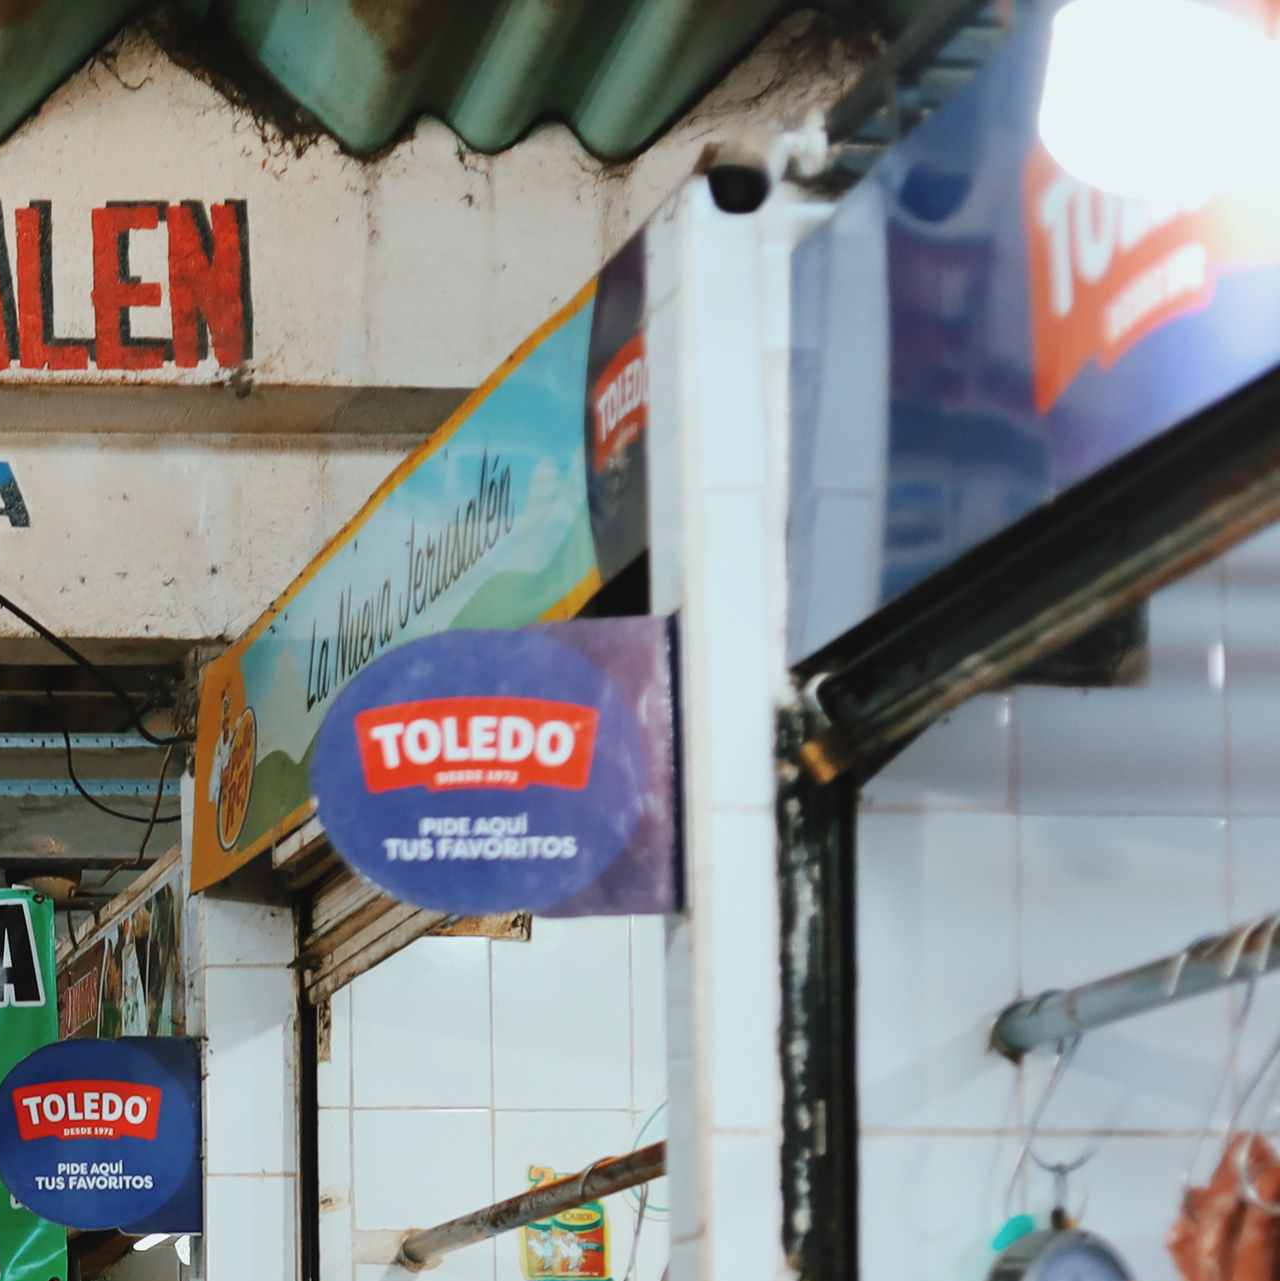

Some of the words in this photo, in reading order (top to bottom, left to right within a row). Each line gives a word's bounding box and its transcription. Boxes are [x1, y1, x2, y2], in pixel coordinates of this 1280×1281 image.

[306, 617, 331, 714] La
[336, 577, 393, 690] Nueva
[370, 714, 576, 769] TOLEDO
[419, 816, 470, 836] PIDE
[471, 812, 529, 839] AQUÍ
[383, 837, 434, 861] TUS
[437, 836, 578, 861] FAVORITOS
[21, 1091, 148, 1126] TOLEDO
[63, 1127, 92, 1137] DESDE
[94, 1126, 114, 1136] 1972
[57, 1162, 88, 1175] PIDE
[90, 1159, 123, 1177] AQUÍ
[35, 1176, 65, 1191] TUS
[68, 1174, 154, 1191] FAVORITOS
